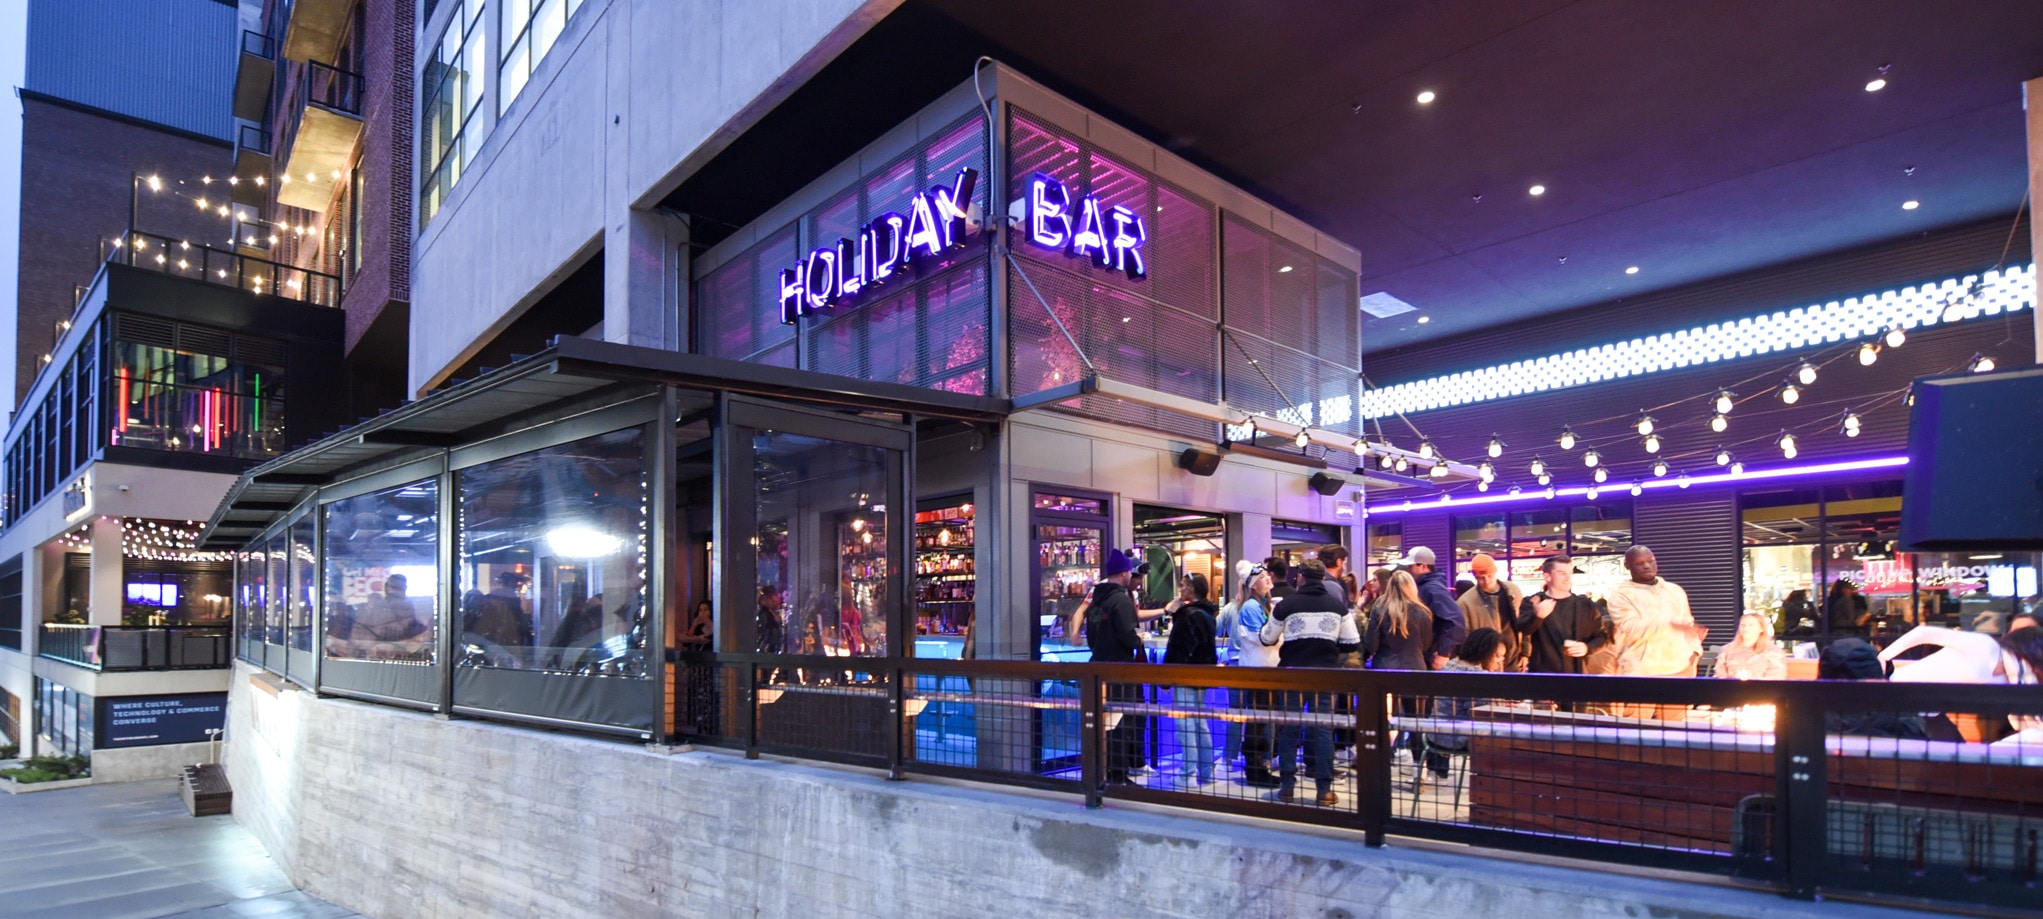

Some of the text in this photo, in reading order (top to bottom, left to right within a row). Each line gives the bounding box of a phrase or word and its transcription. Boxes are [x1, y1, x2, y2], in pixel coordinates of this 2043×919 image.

[779, 166, 1147, 325] HOLIDAY BAR
[1917, 563, 2014, 579] WINDO
[112, 700, 183, 710] WHERE CULTURE,
[113, 708, 166, 718] TECHNOLOGY
[176, 706, 220, 714] COMMERCE
[112, 717, 157, 725] CONVERGE
